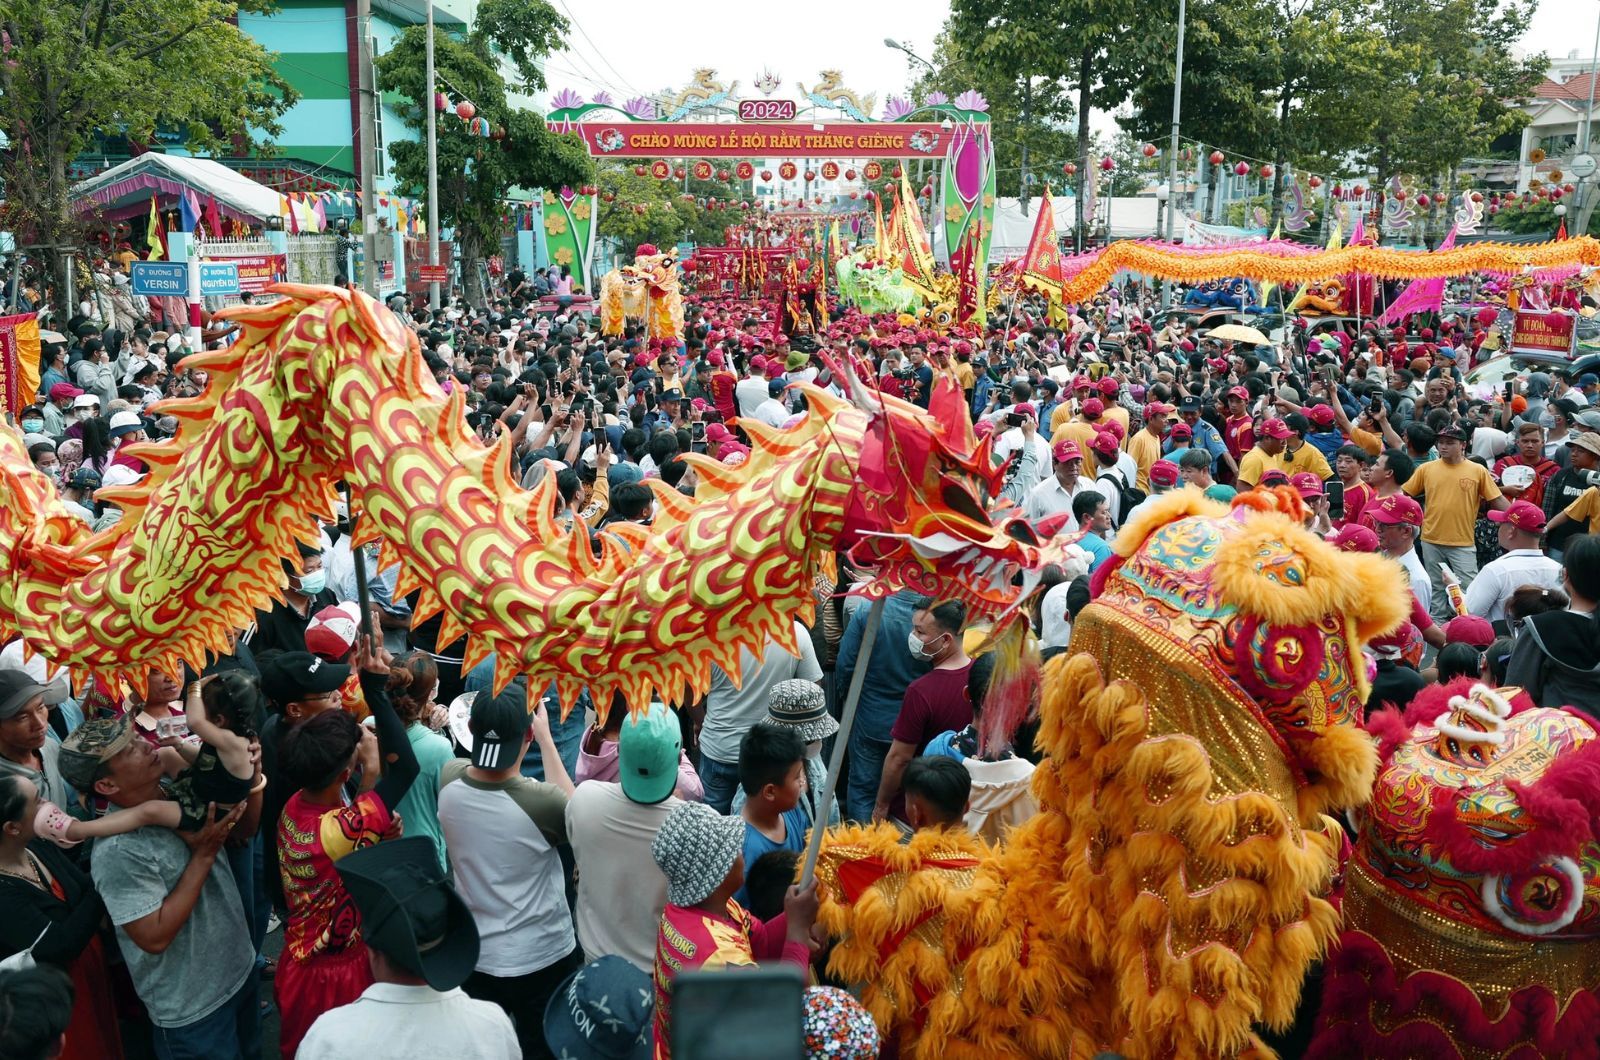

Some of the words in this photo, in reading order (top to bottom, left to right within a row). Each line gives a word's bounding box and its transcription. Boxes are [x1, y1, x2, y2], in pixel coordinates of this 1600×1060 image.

[741, 101, 793, 119] 2024
[630, 131, 671, 148] CHÀO
[674, 131, 718, 148] MÙNG
[719, 130, 738, 148] LỄ
[741, 132, 766, 150] HỘI
[769, 130, 801, 148] RẰM
[804, 132, 854, 149] THÁNG
[857, 132, 904, 149] GIÊNG
[148, 268, 172, 276] ĐƯỜNG
[143, 279, 179, 289] YERSIN
[228, 279, 236, 287] DU
